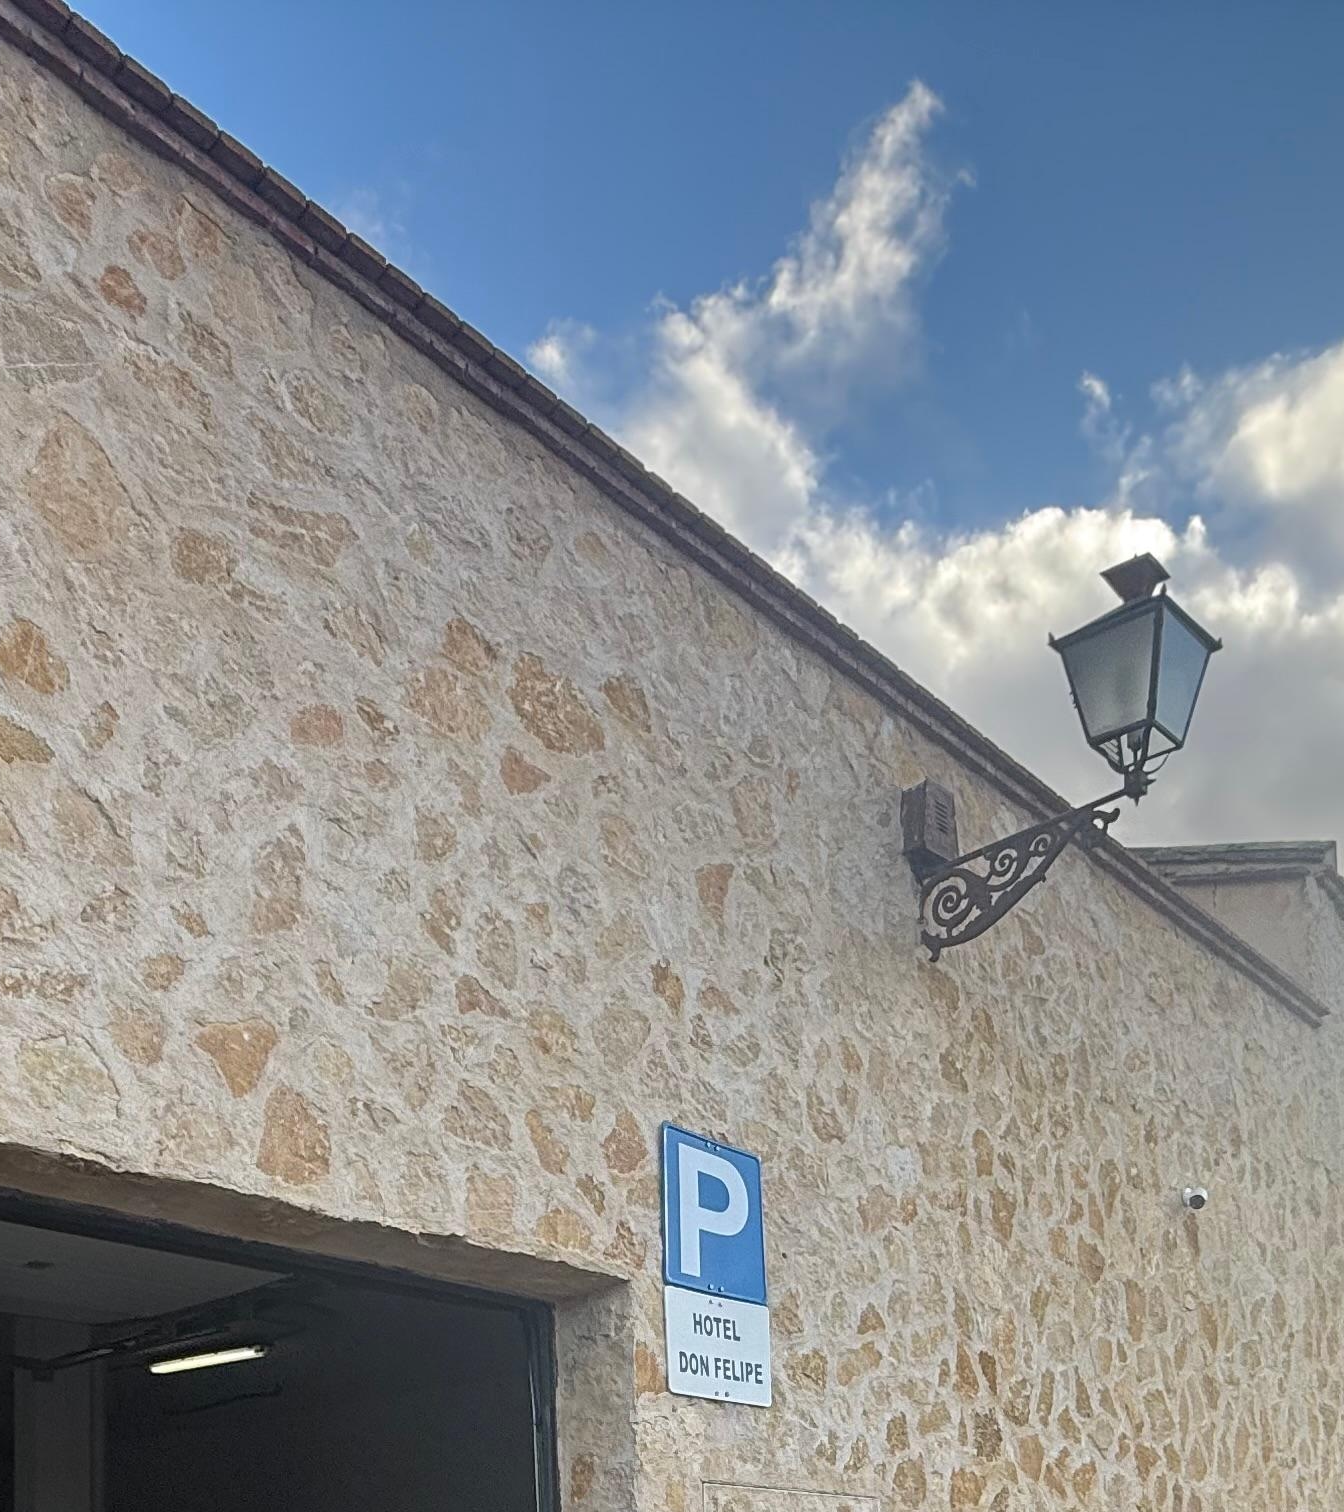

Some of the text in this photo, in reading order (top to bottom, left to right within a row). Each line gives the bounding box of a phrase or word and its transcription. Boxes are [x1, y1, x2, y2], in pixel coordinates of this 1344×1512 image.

[678, 1142, 749, 1278] P
[693, 1313, 741, 1342] HOTEL
[679, 1351, 763, 1385] DON FELIPE
